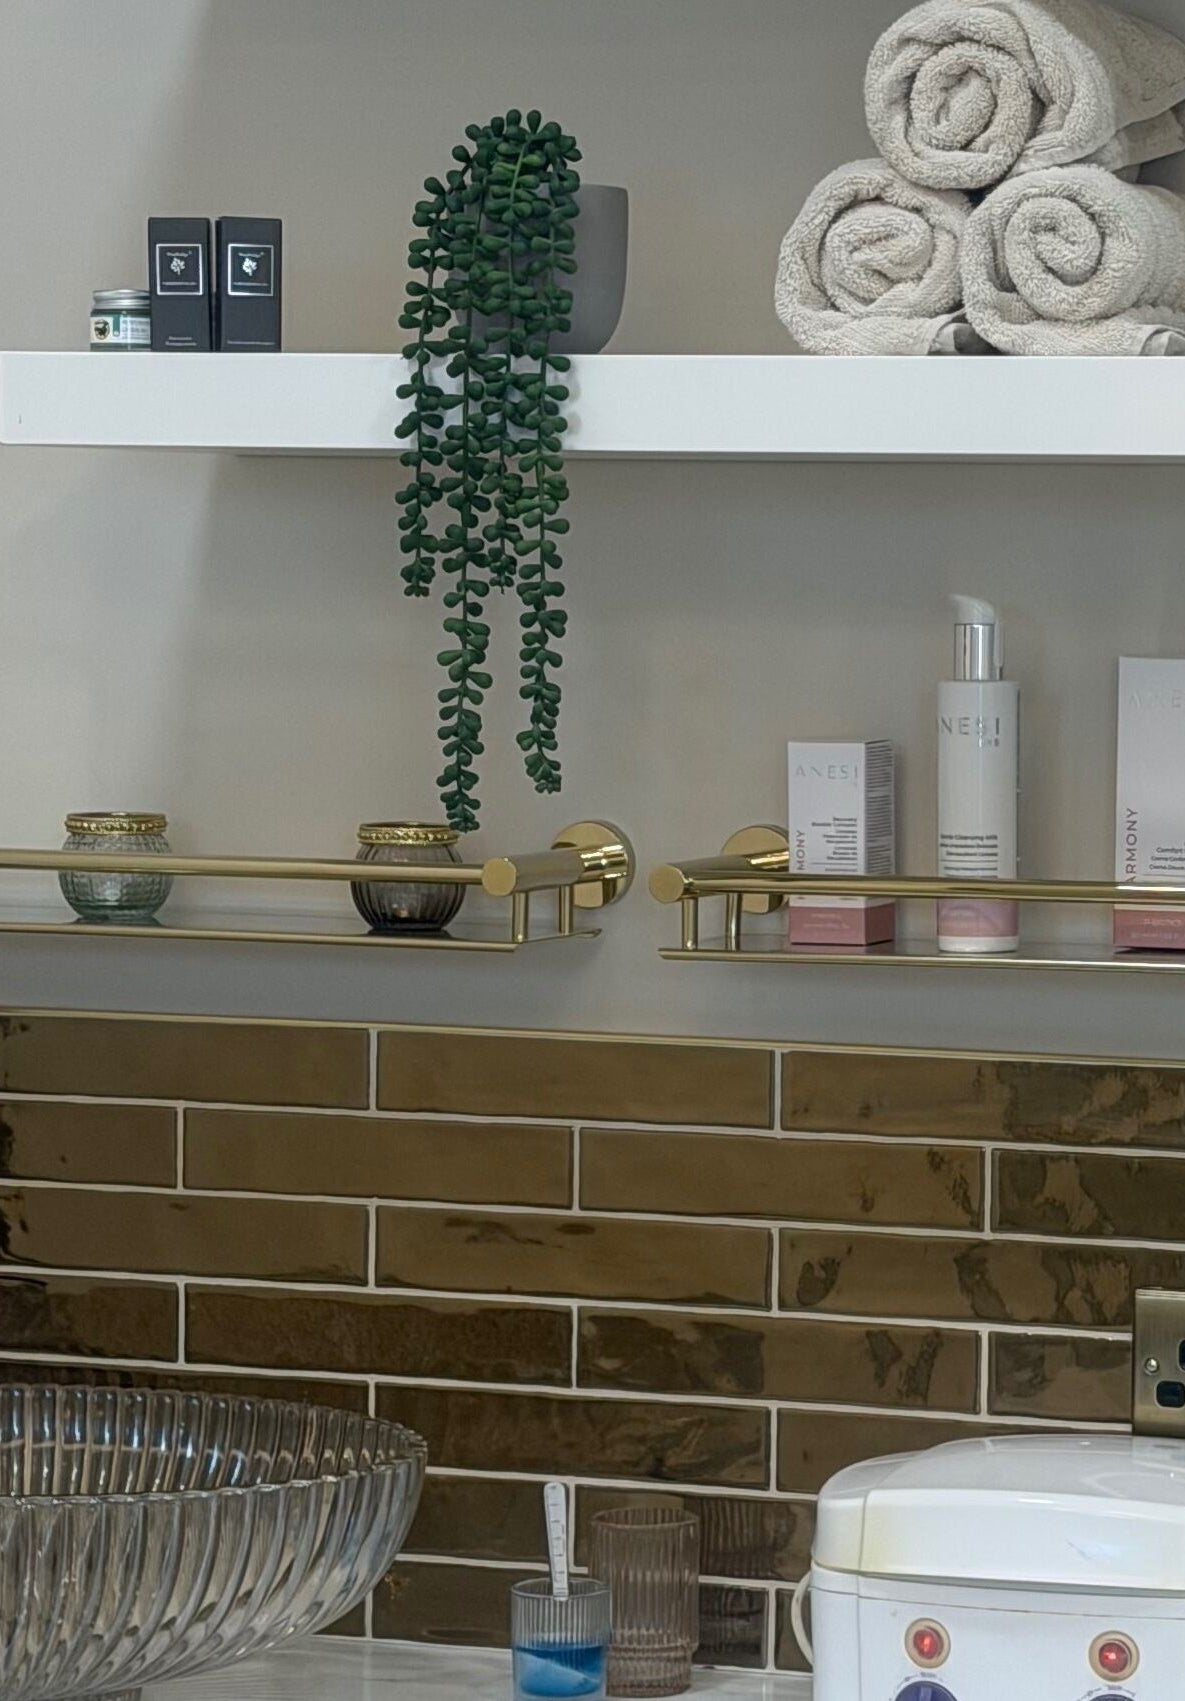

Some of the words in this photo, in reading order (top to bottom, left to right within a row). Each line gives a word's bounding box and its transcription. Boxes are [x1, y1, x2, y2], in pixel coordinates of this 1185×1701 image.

[795, 765, 858, 780] ANESI
[795, 830, 807, 871] MONY
[1125, 807, 1138, 884] ARMONY
